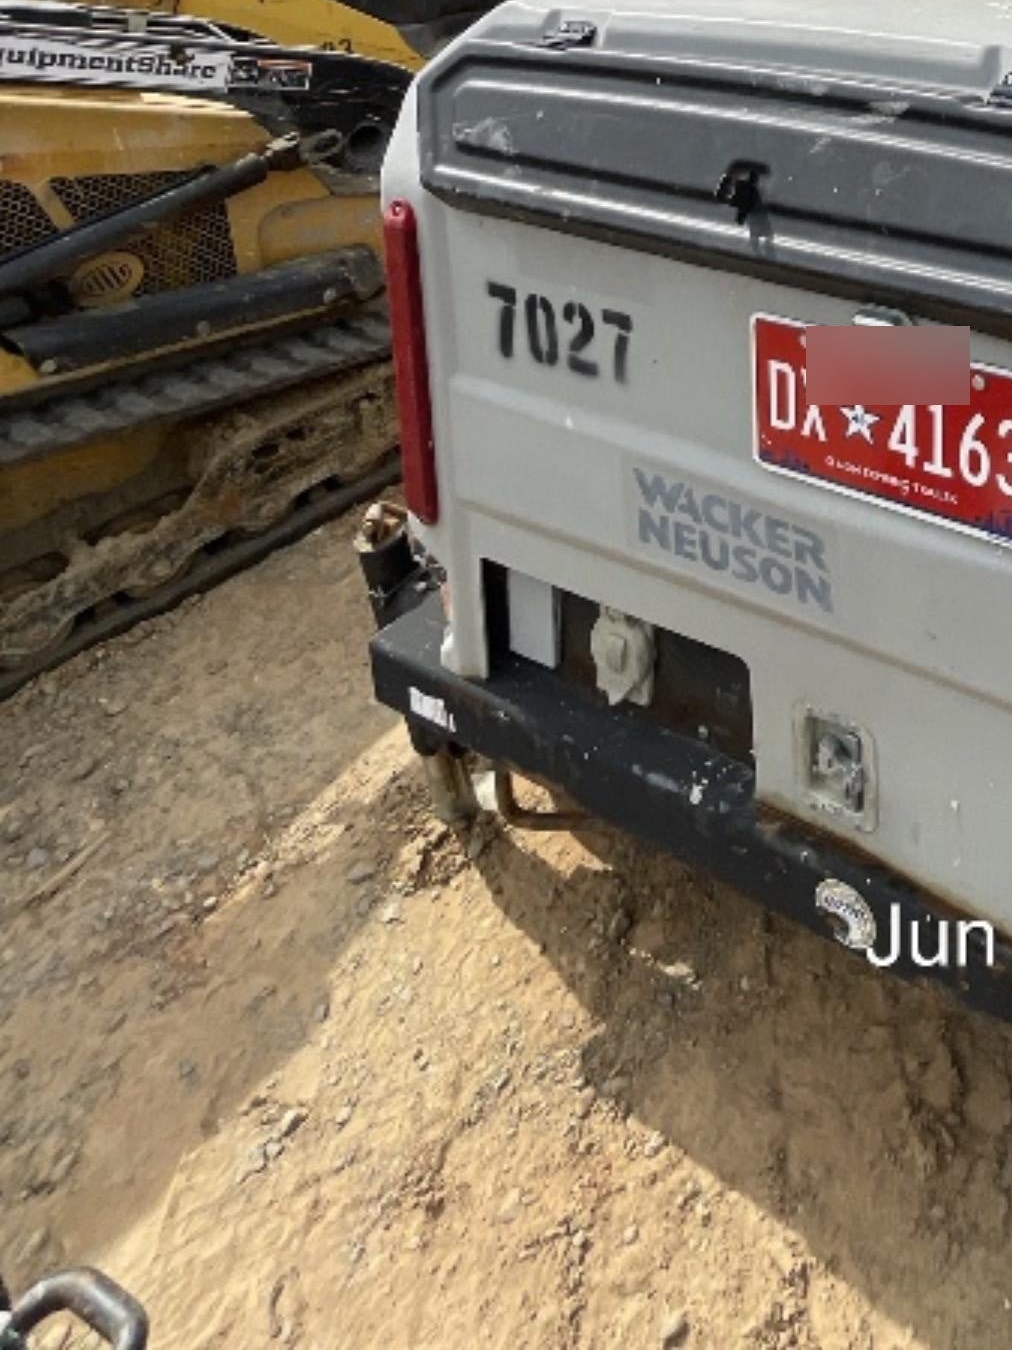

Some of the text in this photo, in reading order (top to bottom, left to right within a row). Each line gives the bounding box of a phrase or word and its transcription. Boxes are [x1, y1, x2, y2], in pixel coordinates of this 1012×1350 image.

[487, 280, 633, 384] 7027
[633, 467, 830, 574] WACKER
[638, 506, 834, 615] NEUSON
